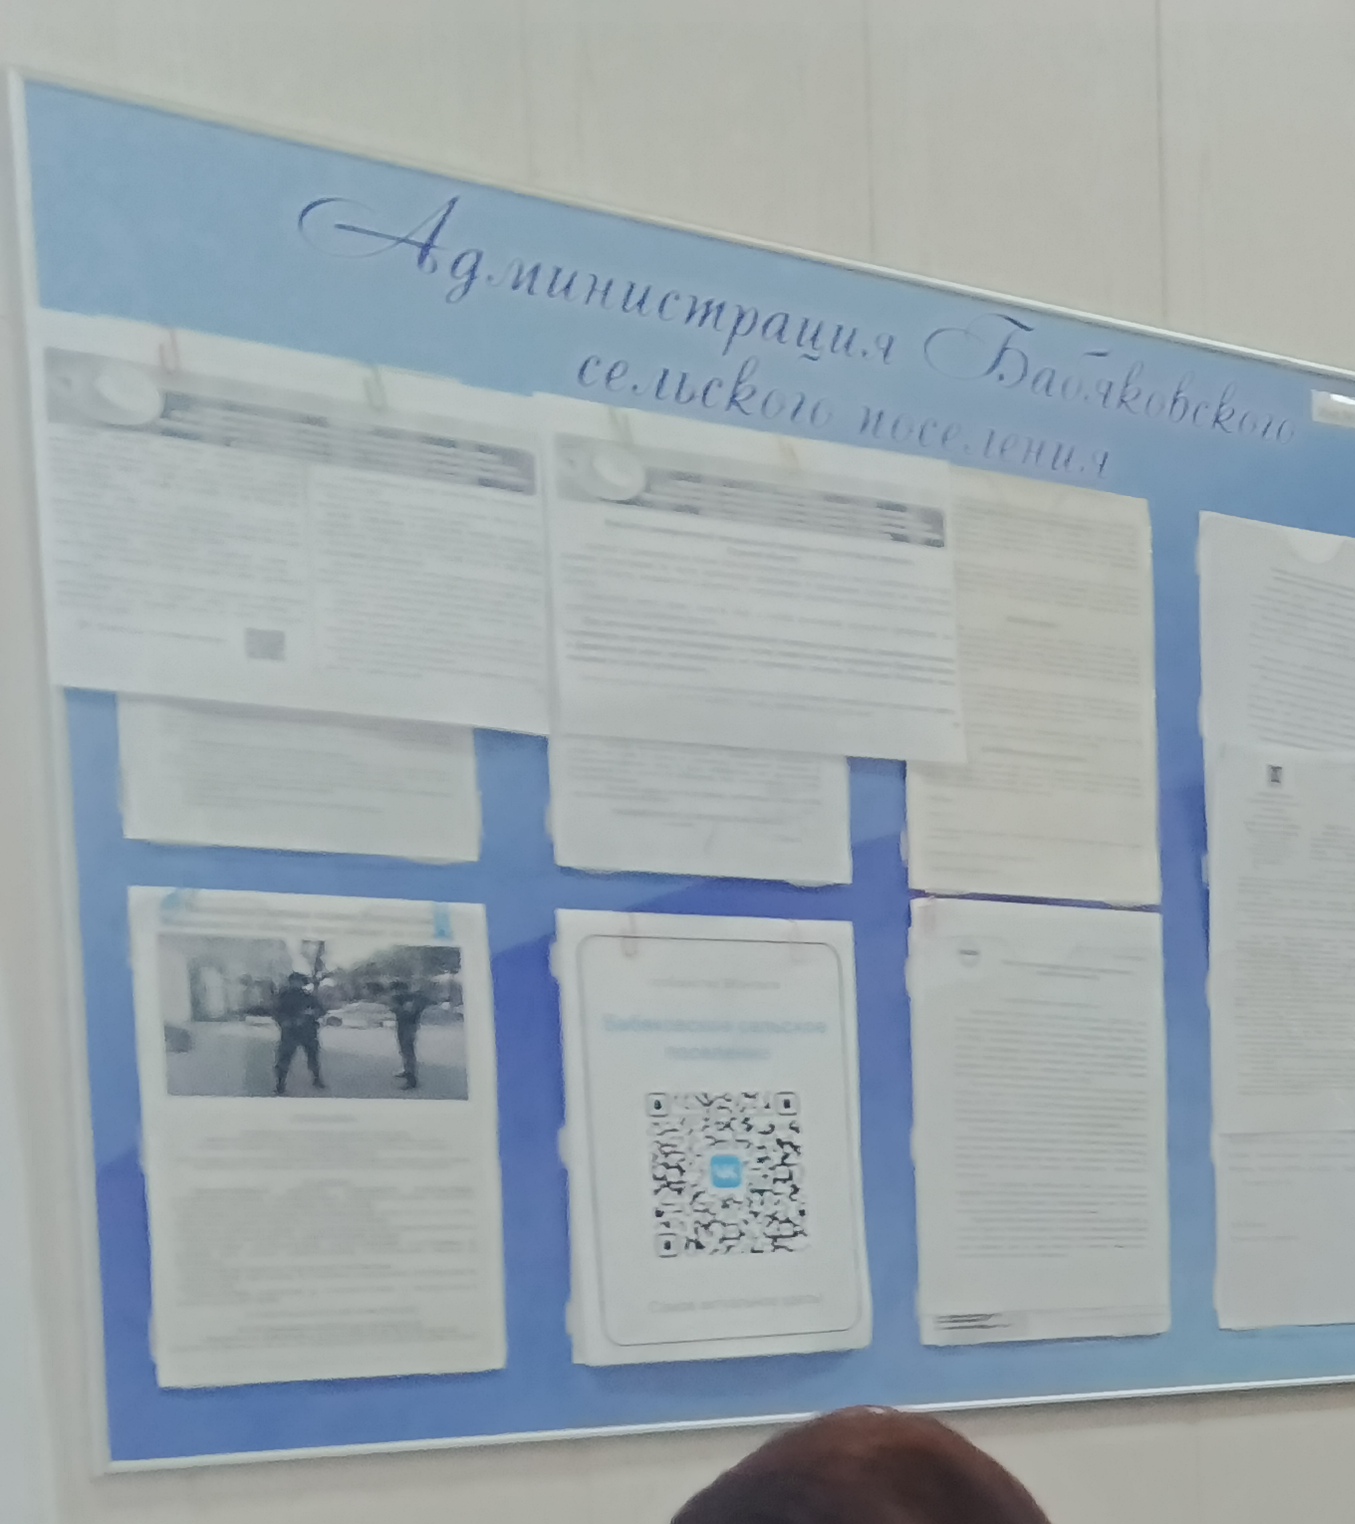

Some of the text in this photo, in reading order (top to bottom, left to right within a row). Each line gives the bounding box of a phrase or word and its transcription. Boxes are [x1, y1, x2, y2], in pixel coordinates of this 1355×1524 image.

[298, 195, 894, 366] Администрация
[576, 353, 1111, 482] сельского поселения
